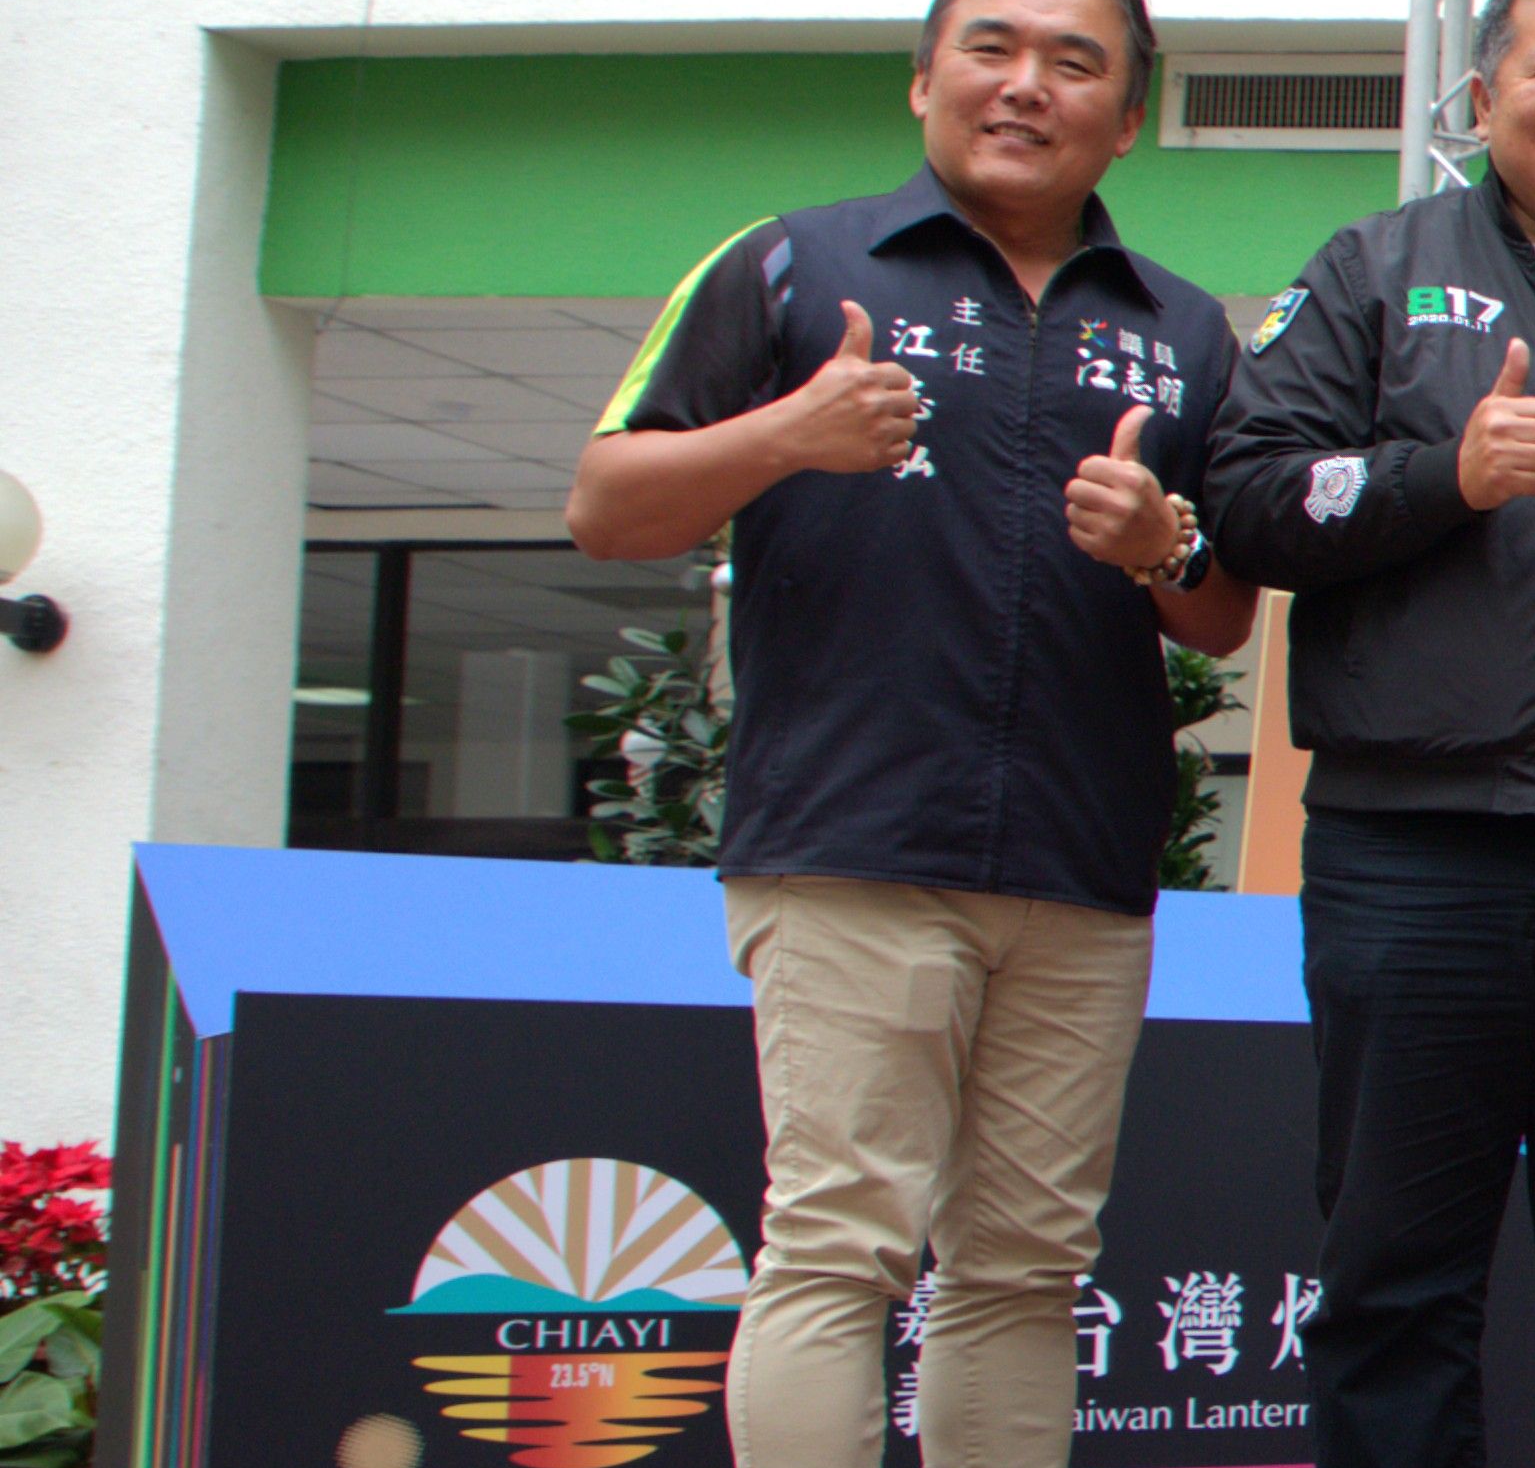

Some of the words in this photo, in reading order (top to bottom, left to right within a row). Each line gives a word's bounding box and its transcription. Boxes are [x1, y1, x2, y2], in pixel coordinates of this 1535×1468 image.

[1406, 285, 1505, 325] 817
[951, 296, 986, 376] 主任
[1076, 346, 1186, 420] 江志明
[495, 1319, 670, 1350] CHIAYI
[550, 1363, 614, 1388] 23.5°N
[1071, 1399, 1172, 1432] aiwan
